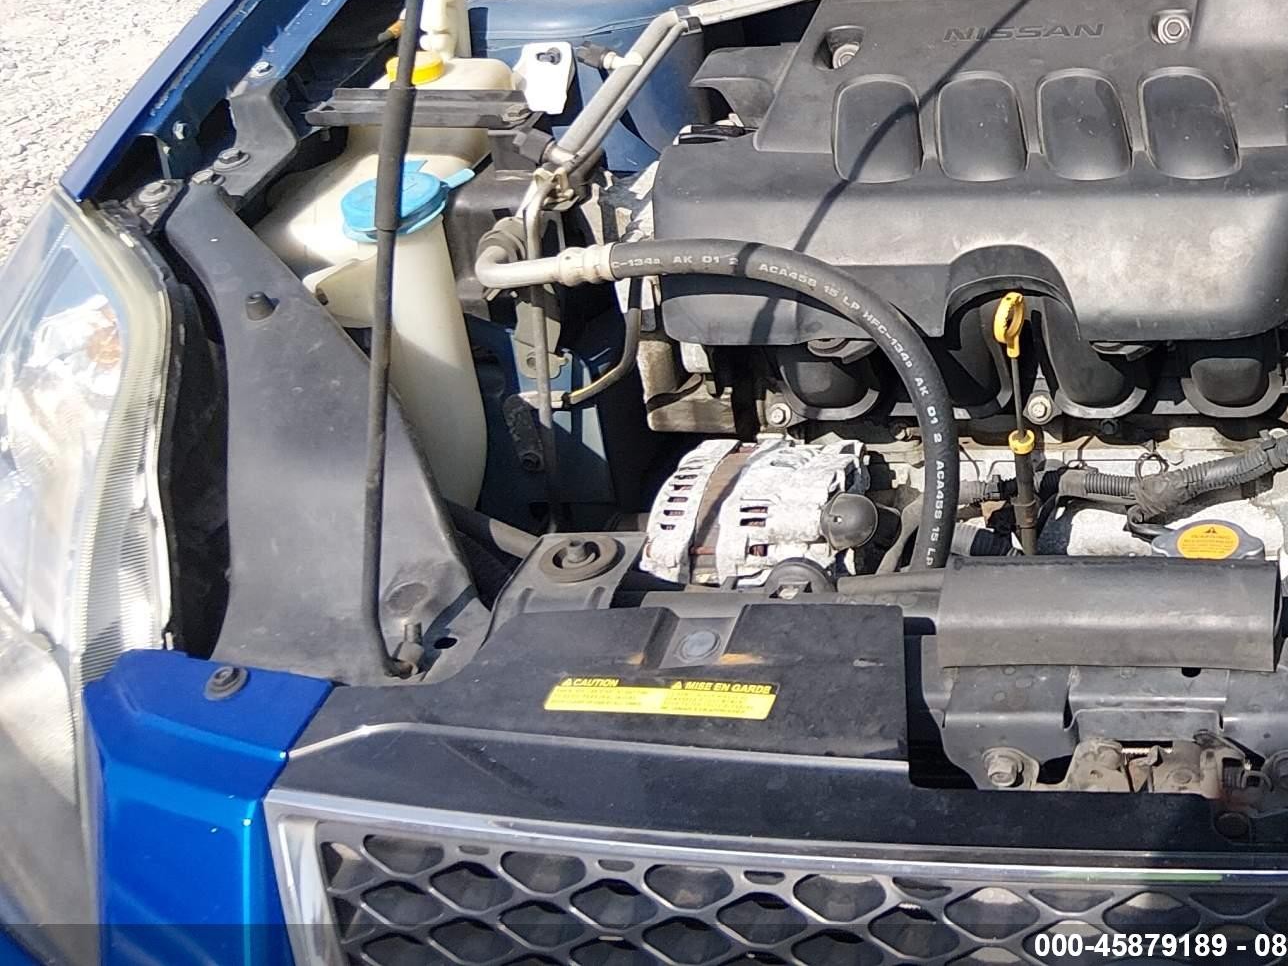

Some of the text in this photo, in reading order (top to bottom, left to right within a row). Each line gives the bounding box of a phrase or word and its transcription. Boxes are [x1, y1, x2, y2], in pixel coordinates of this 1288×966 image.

[944, 23, 1104, 42] NISSAN
[672, 255, 694, 265] AK
[823, 284, 840, 298] 15
[842, 295, 861, 311] LP
[914, 377, 929, 397] AK
[930, 526, 940, 542] 15
[573, 677, 619, 688] CAUTION
[684, 680, 772, 695] MISE EN GARDE
